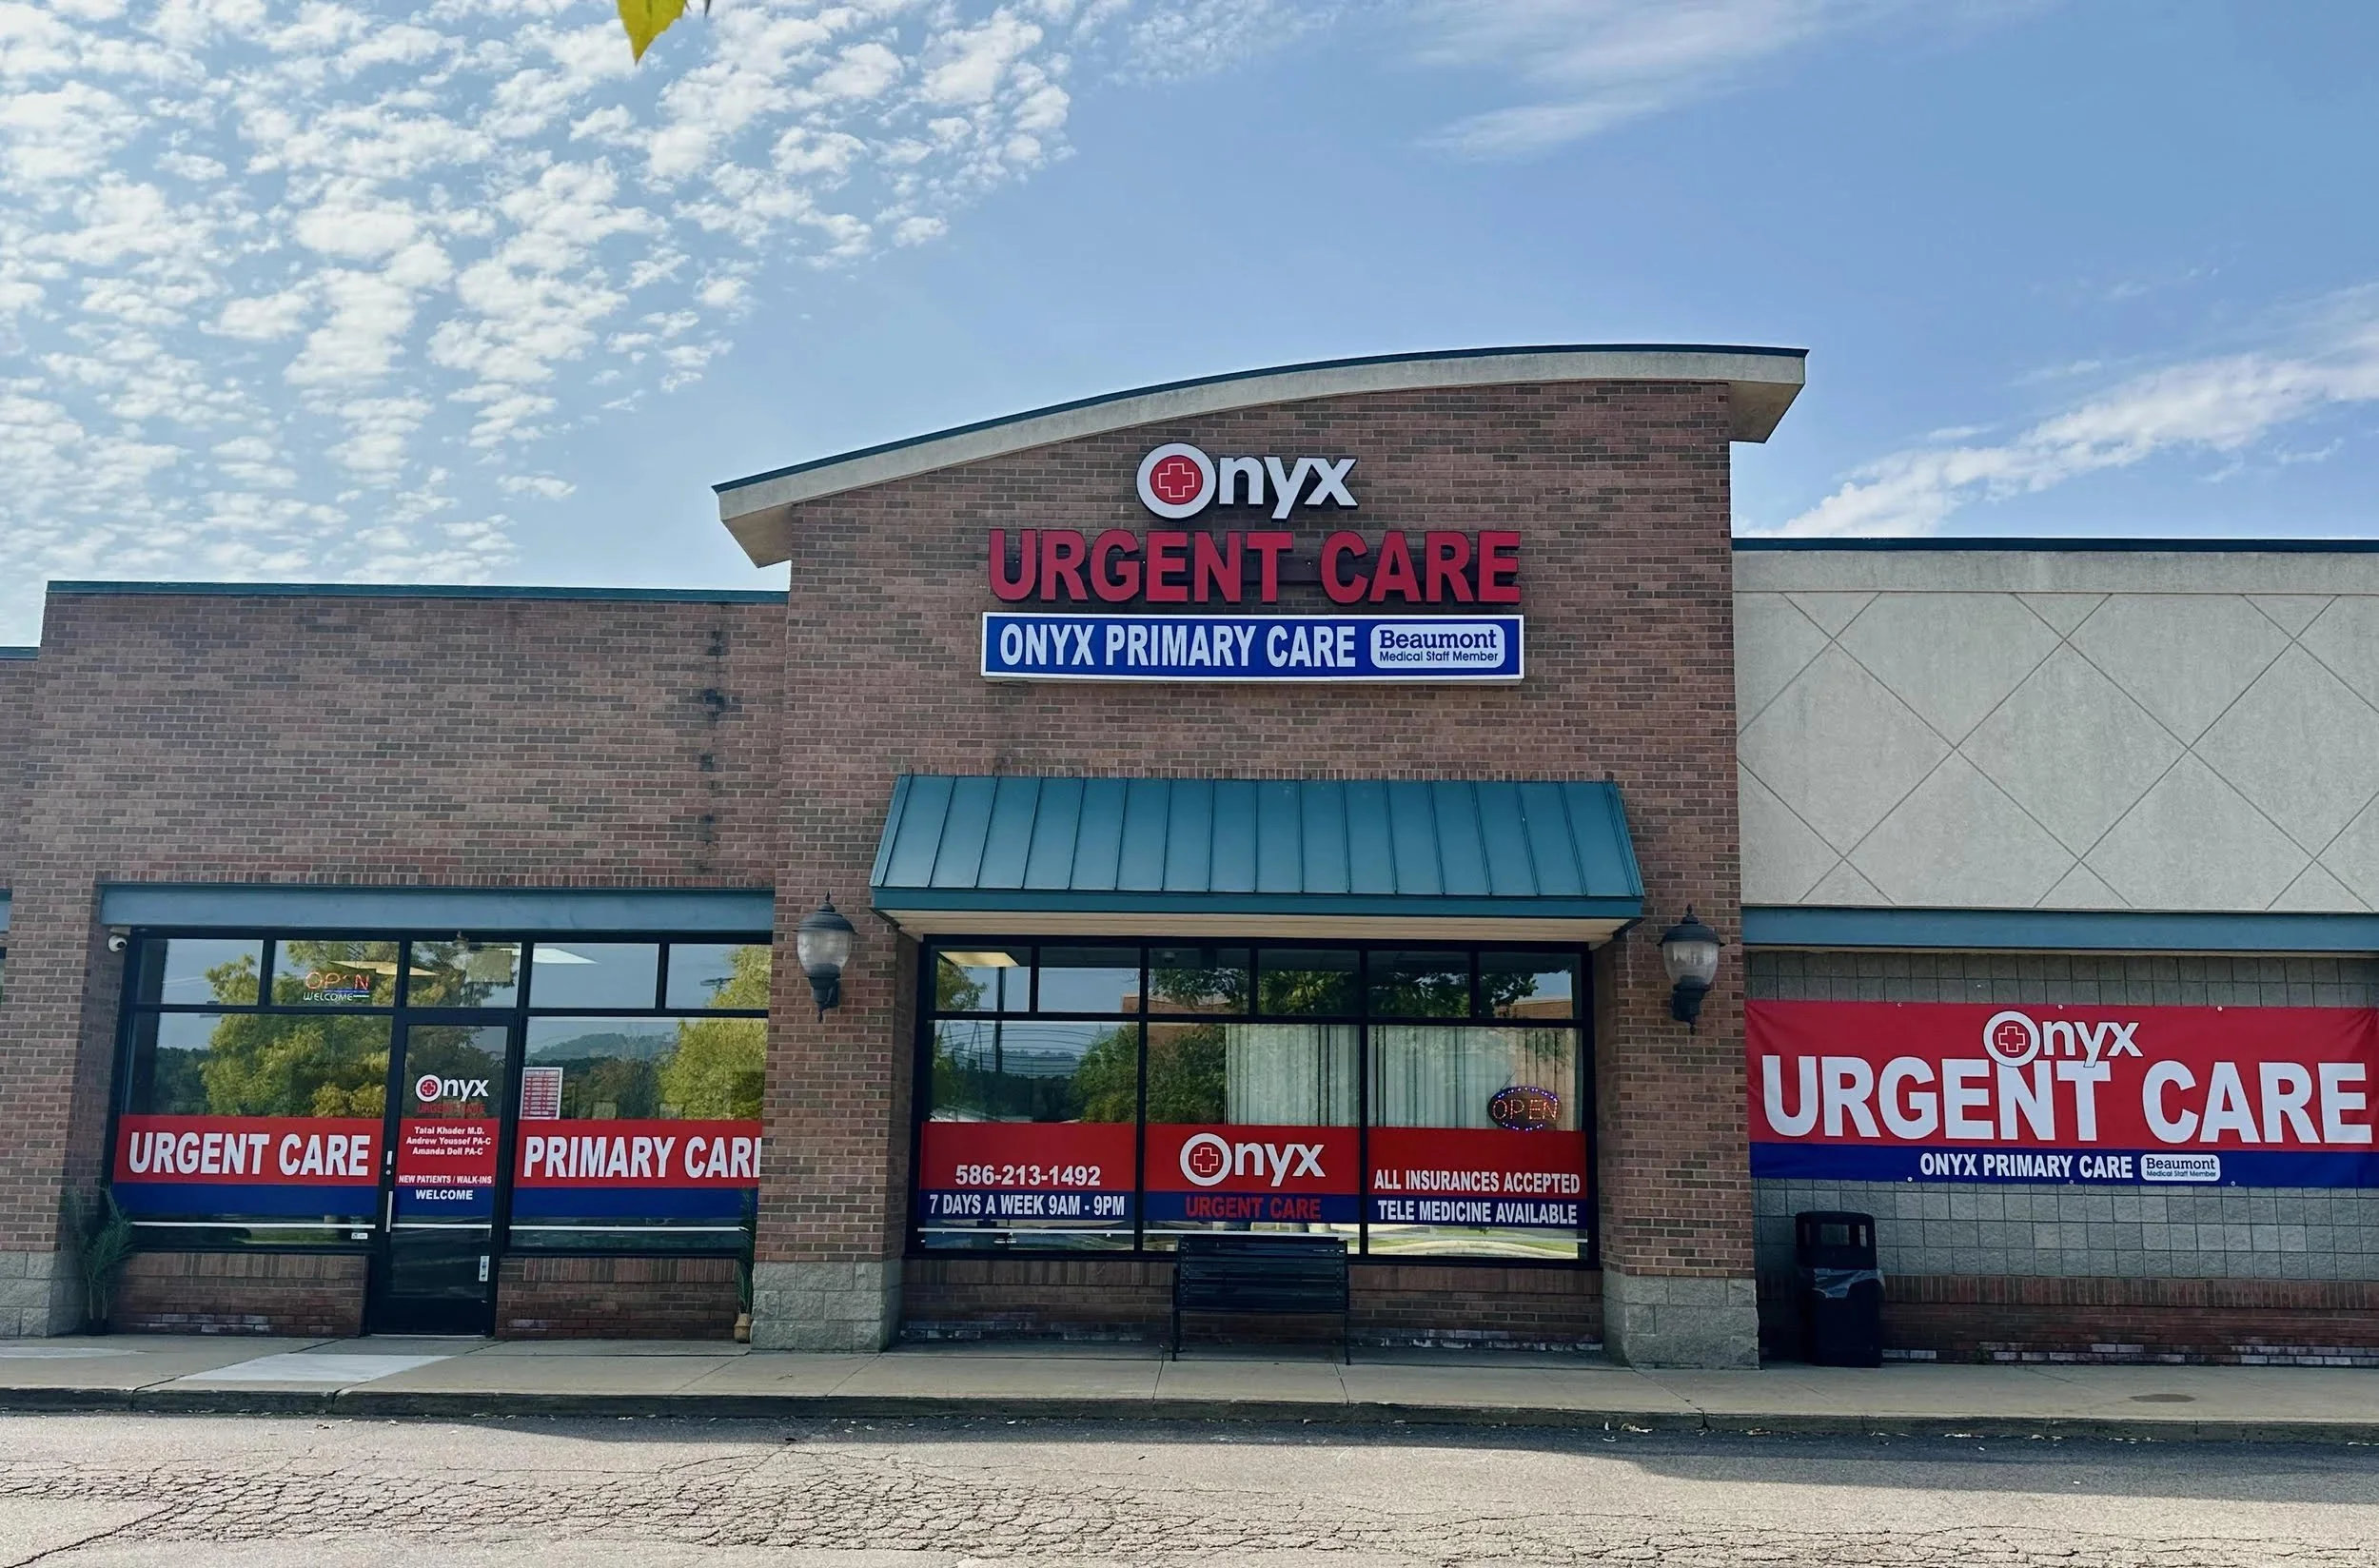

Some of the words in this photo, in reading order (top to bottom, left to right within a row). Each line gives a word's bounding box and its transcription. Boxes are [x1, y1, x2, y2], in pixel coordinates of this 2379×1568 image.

[1136, 442, 1359, 519] Onyx
[989, 529, 1293, 603] URGENT
[1320, 531, 1521, 603] CARE
[1000, 624, 1094, 666] ONYX
[1105, 625, 1257, 667] PRIMARY
[1267, 626, 1356, 668] CARE
[1379, 629, 1497, 649] Beaumont
[1379, 651, 1423, 661] Medical
[1426, 651, 1449, 661] Staff
[1452, 651, 1498, 661] Member
[303, 991, 353, 1001] WELCOME
[1983, 1010, 2143, 1068] Onyx
[415, 1074, 489, 1102] Onyx
[1761, 1054, 2111, 1142] URGENT
[2141, 1061, 2372, 1144] CARE
[1492, 1098, 1558, 1121] OPEN
[437, 1127, 465, 1135] Khader
[467, 1127, 484, 1135] M.D.
[439, 1137, 471, 1146] Youssef
[473, 1137, 492, 1146] PA-C
[128, 1132, 269, 1174] URGENT
[278, 1134, 370, 1176] CARE
[523, 1136, 676, 1178] PRIMARY
[1180, 1132, 1326, 1186] Onyx
[1920, 1152, 1977, 1176] ONYX
[1983, 1154, 2073, 1178] PRIMARY
[2079, 1155, 2133, 1179] CARE
[2146, 1158, 2215, 1169] Beaumont
[417, 1175, 451, 1184] PATIENTS
[955, 1165, 1101, 1186] 586-213-1492
[1374, 1169, 1401, 1189] ALL
[1406, 1170, 1499, 1192] INSURANCES
[1504, 1172, 1580, 1194] ACCEPTED
[416, 1189, 473, 1200] WELCOME
[930, 1195, 937, 1214] 7
[943, 1195, 980, 1214] DAYS
[985, 1195, 996, 1214] A
[1000, 1195, 1044, 1215] WEEK
[1049, 1195, 1080, 1215] 9AM
[1093, 1196, 1125, 1216] 9PM
[1186, 1195, 1264, 1219] URGENT
[1269, 1197, 1321, 1220] CARE
[1378, 1200, 1414, 1221] TELE
[1419, 1201, 1491, 1223] MEDICINE
[1496, 1203, 1577, 1225] AVAILABLE
